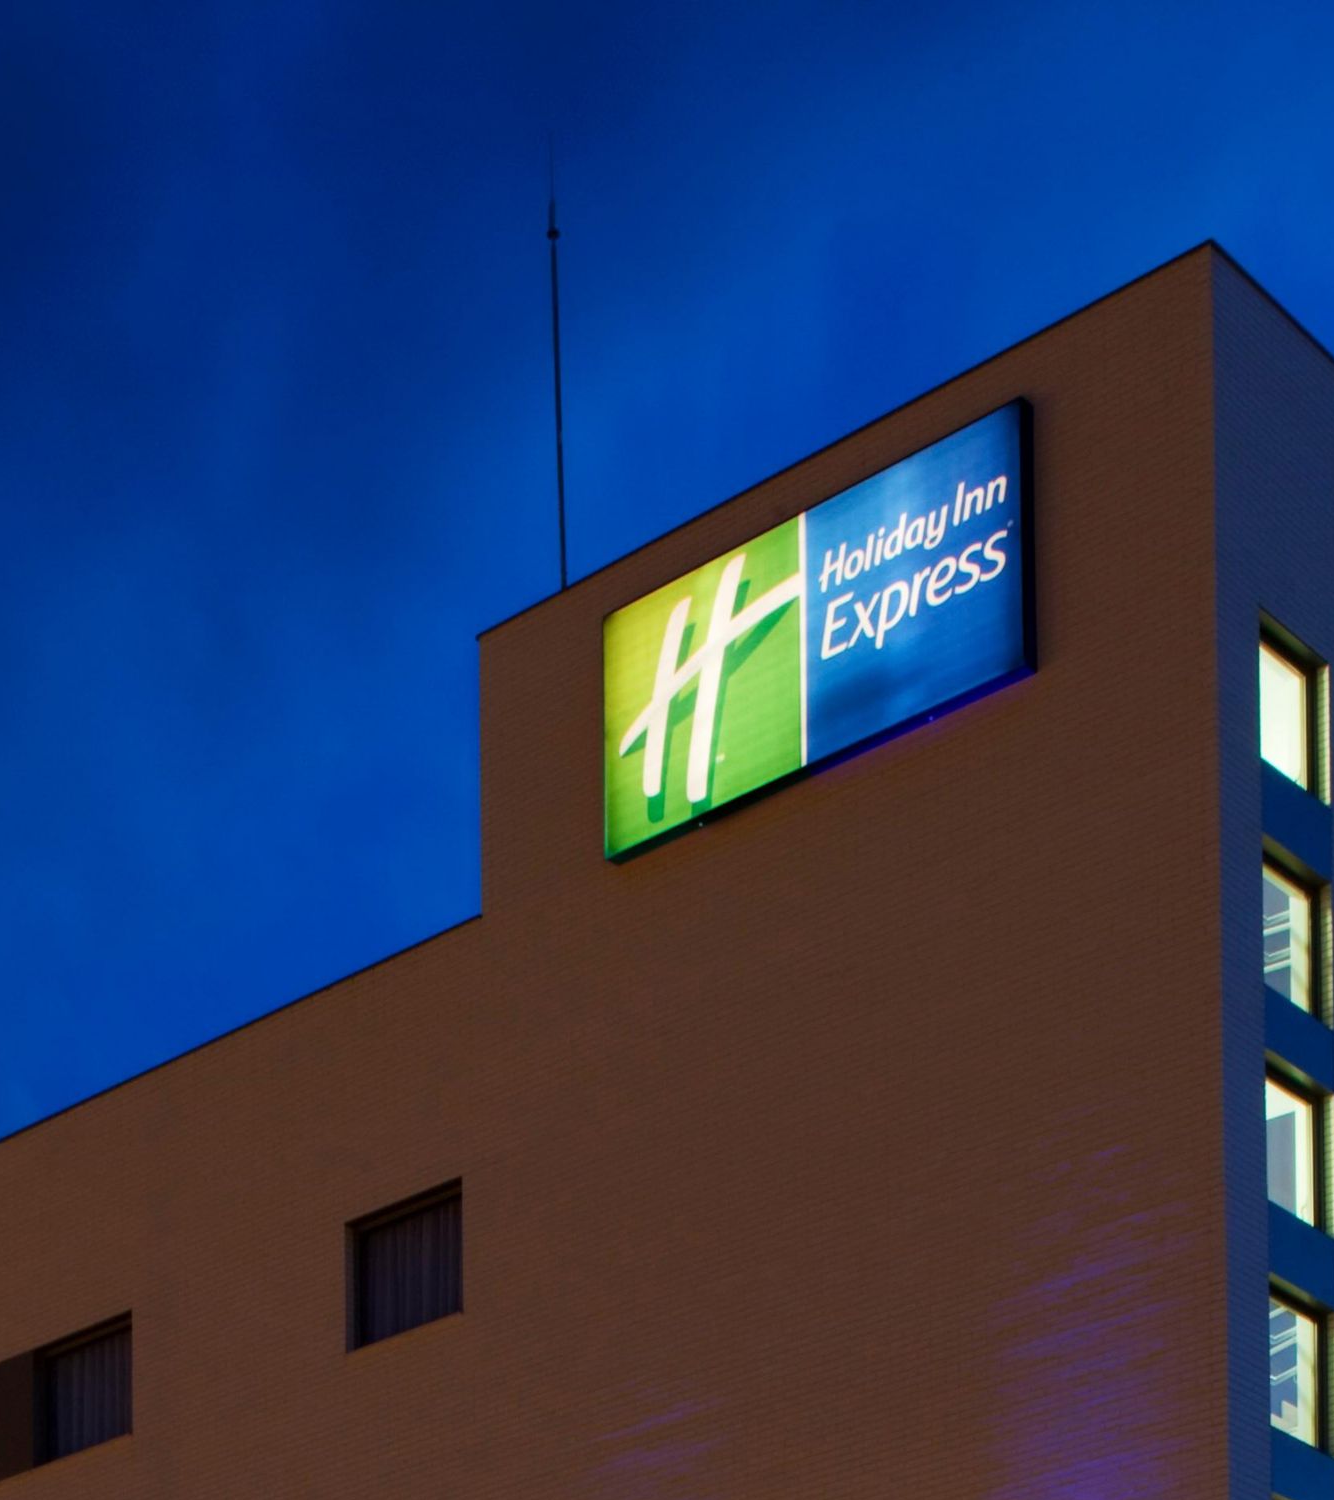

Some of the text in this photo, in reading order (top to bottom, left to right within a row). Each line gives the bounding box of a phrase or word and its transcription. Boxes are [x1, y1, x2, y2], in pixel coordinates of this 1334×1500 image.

[819, 475, 1008, 594] Holiday Inn
[820, 529, 1009, 661] Express
[619, 553, 802, 803] H
